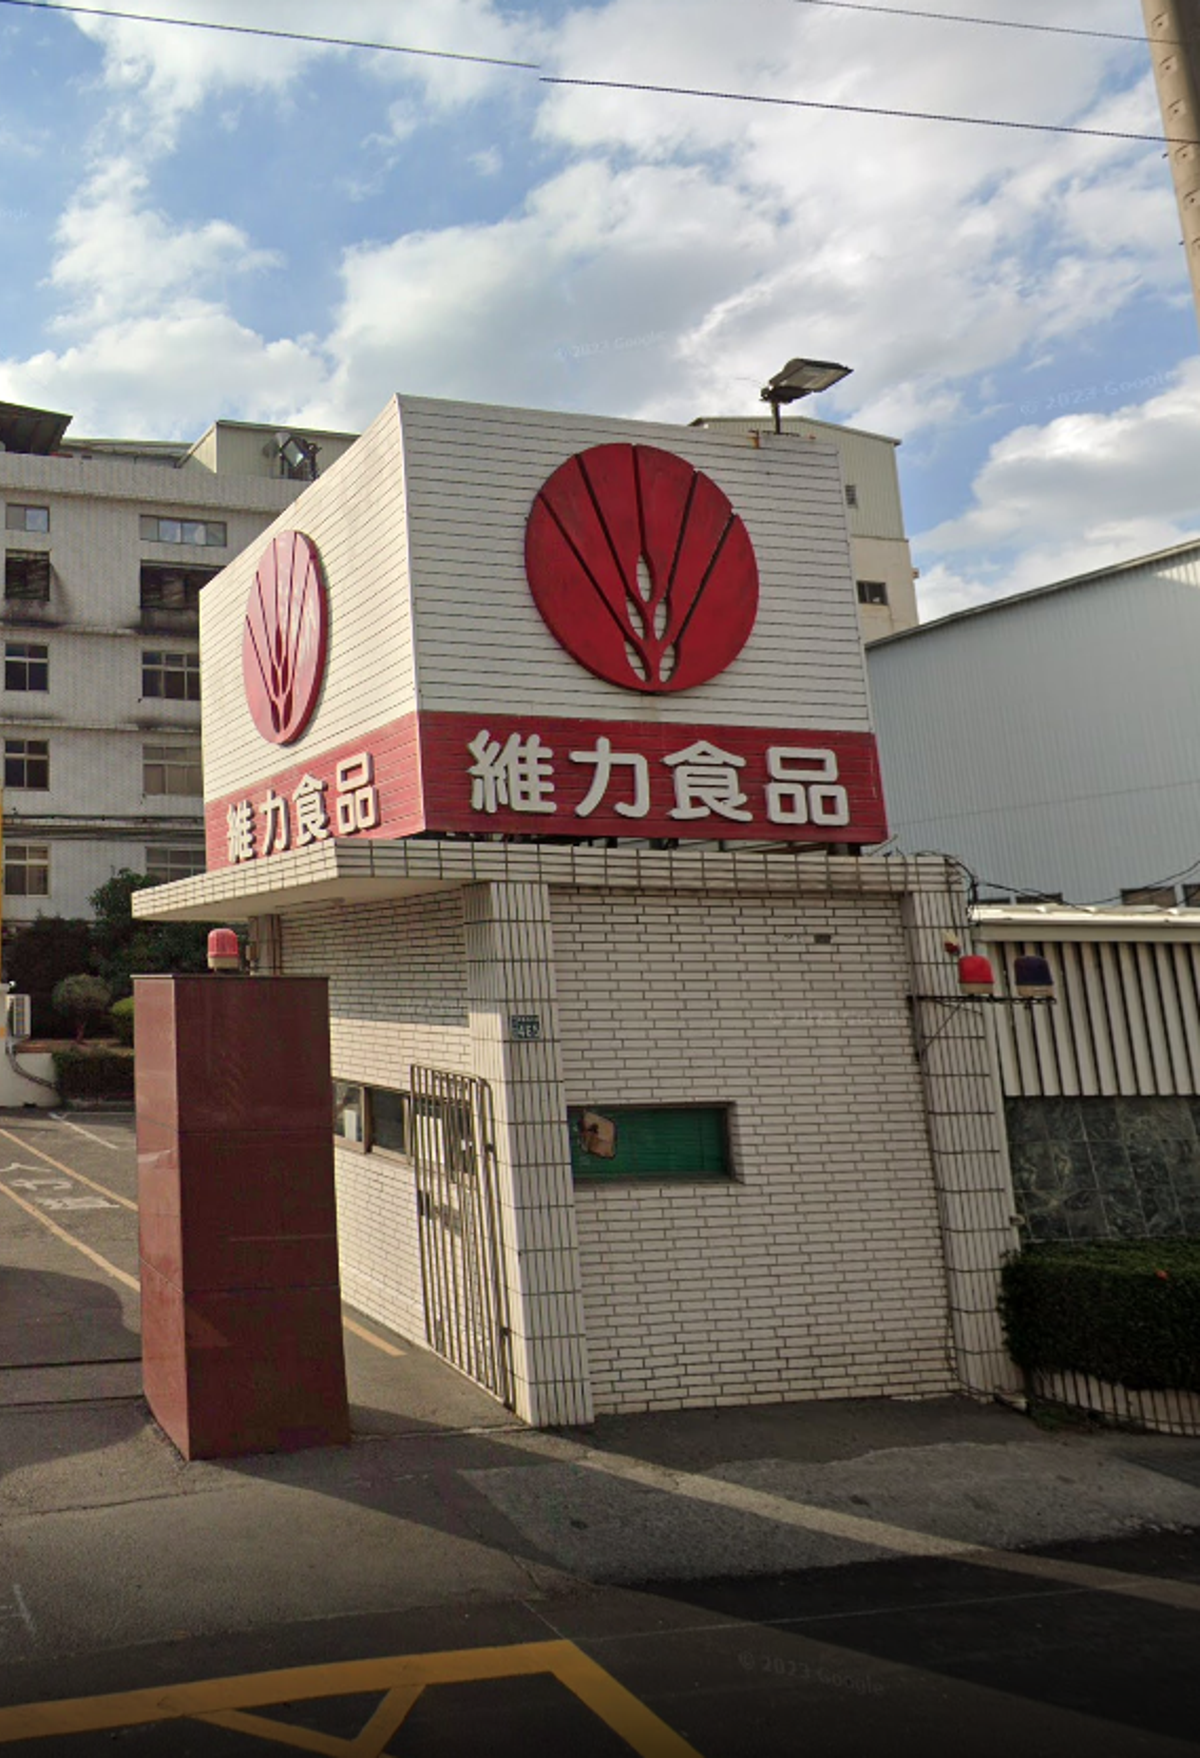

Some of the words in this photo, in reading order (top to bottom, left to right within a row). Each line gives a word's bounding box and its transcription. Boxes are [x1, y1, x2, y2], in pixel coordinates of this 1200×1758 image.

[226, 751, 381, 864] 維力食品
[466, 729, 850, 826] 維力食品
